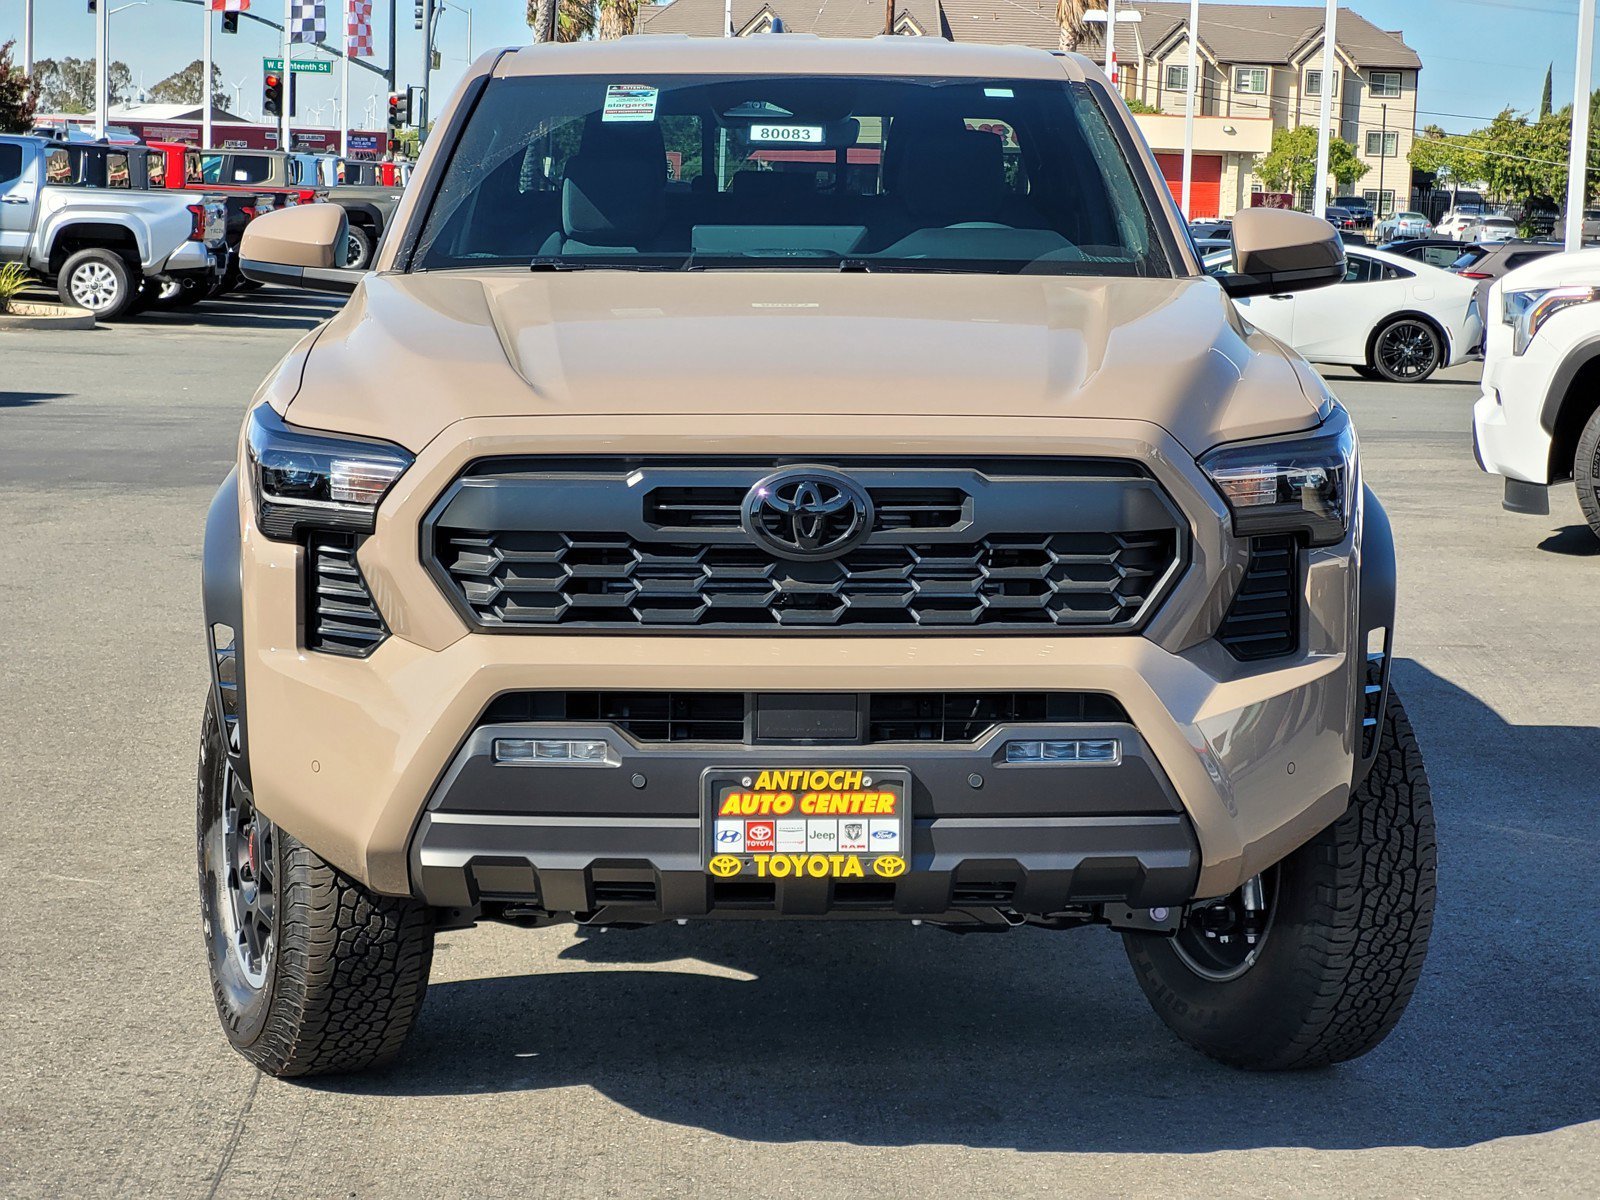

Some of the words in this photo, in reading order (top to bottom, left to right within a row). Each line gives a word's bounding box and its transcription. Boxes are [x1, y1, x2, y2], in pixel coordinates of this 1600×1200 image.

[267, 61, 276, 69] W.
[318, 63, 327, 71] St
[760, 128, 811, 140] 80083
[754, 769, 863, 791] ANTIOCH
[718, 792, 795, 816] AUTO
[799, 792, 897, 815] CENTER
[809, 830, 835, 840] Jeep
[754, 854, 864, 878] TOYOTA
